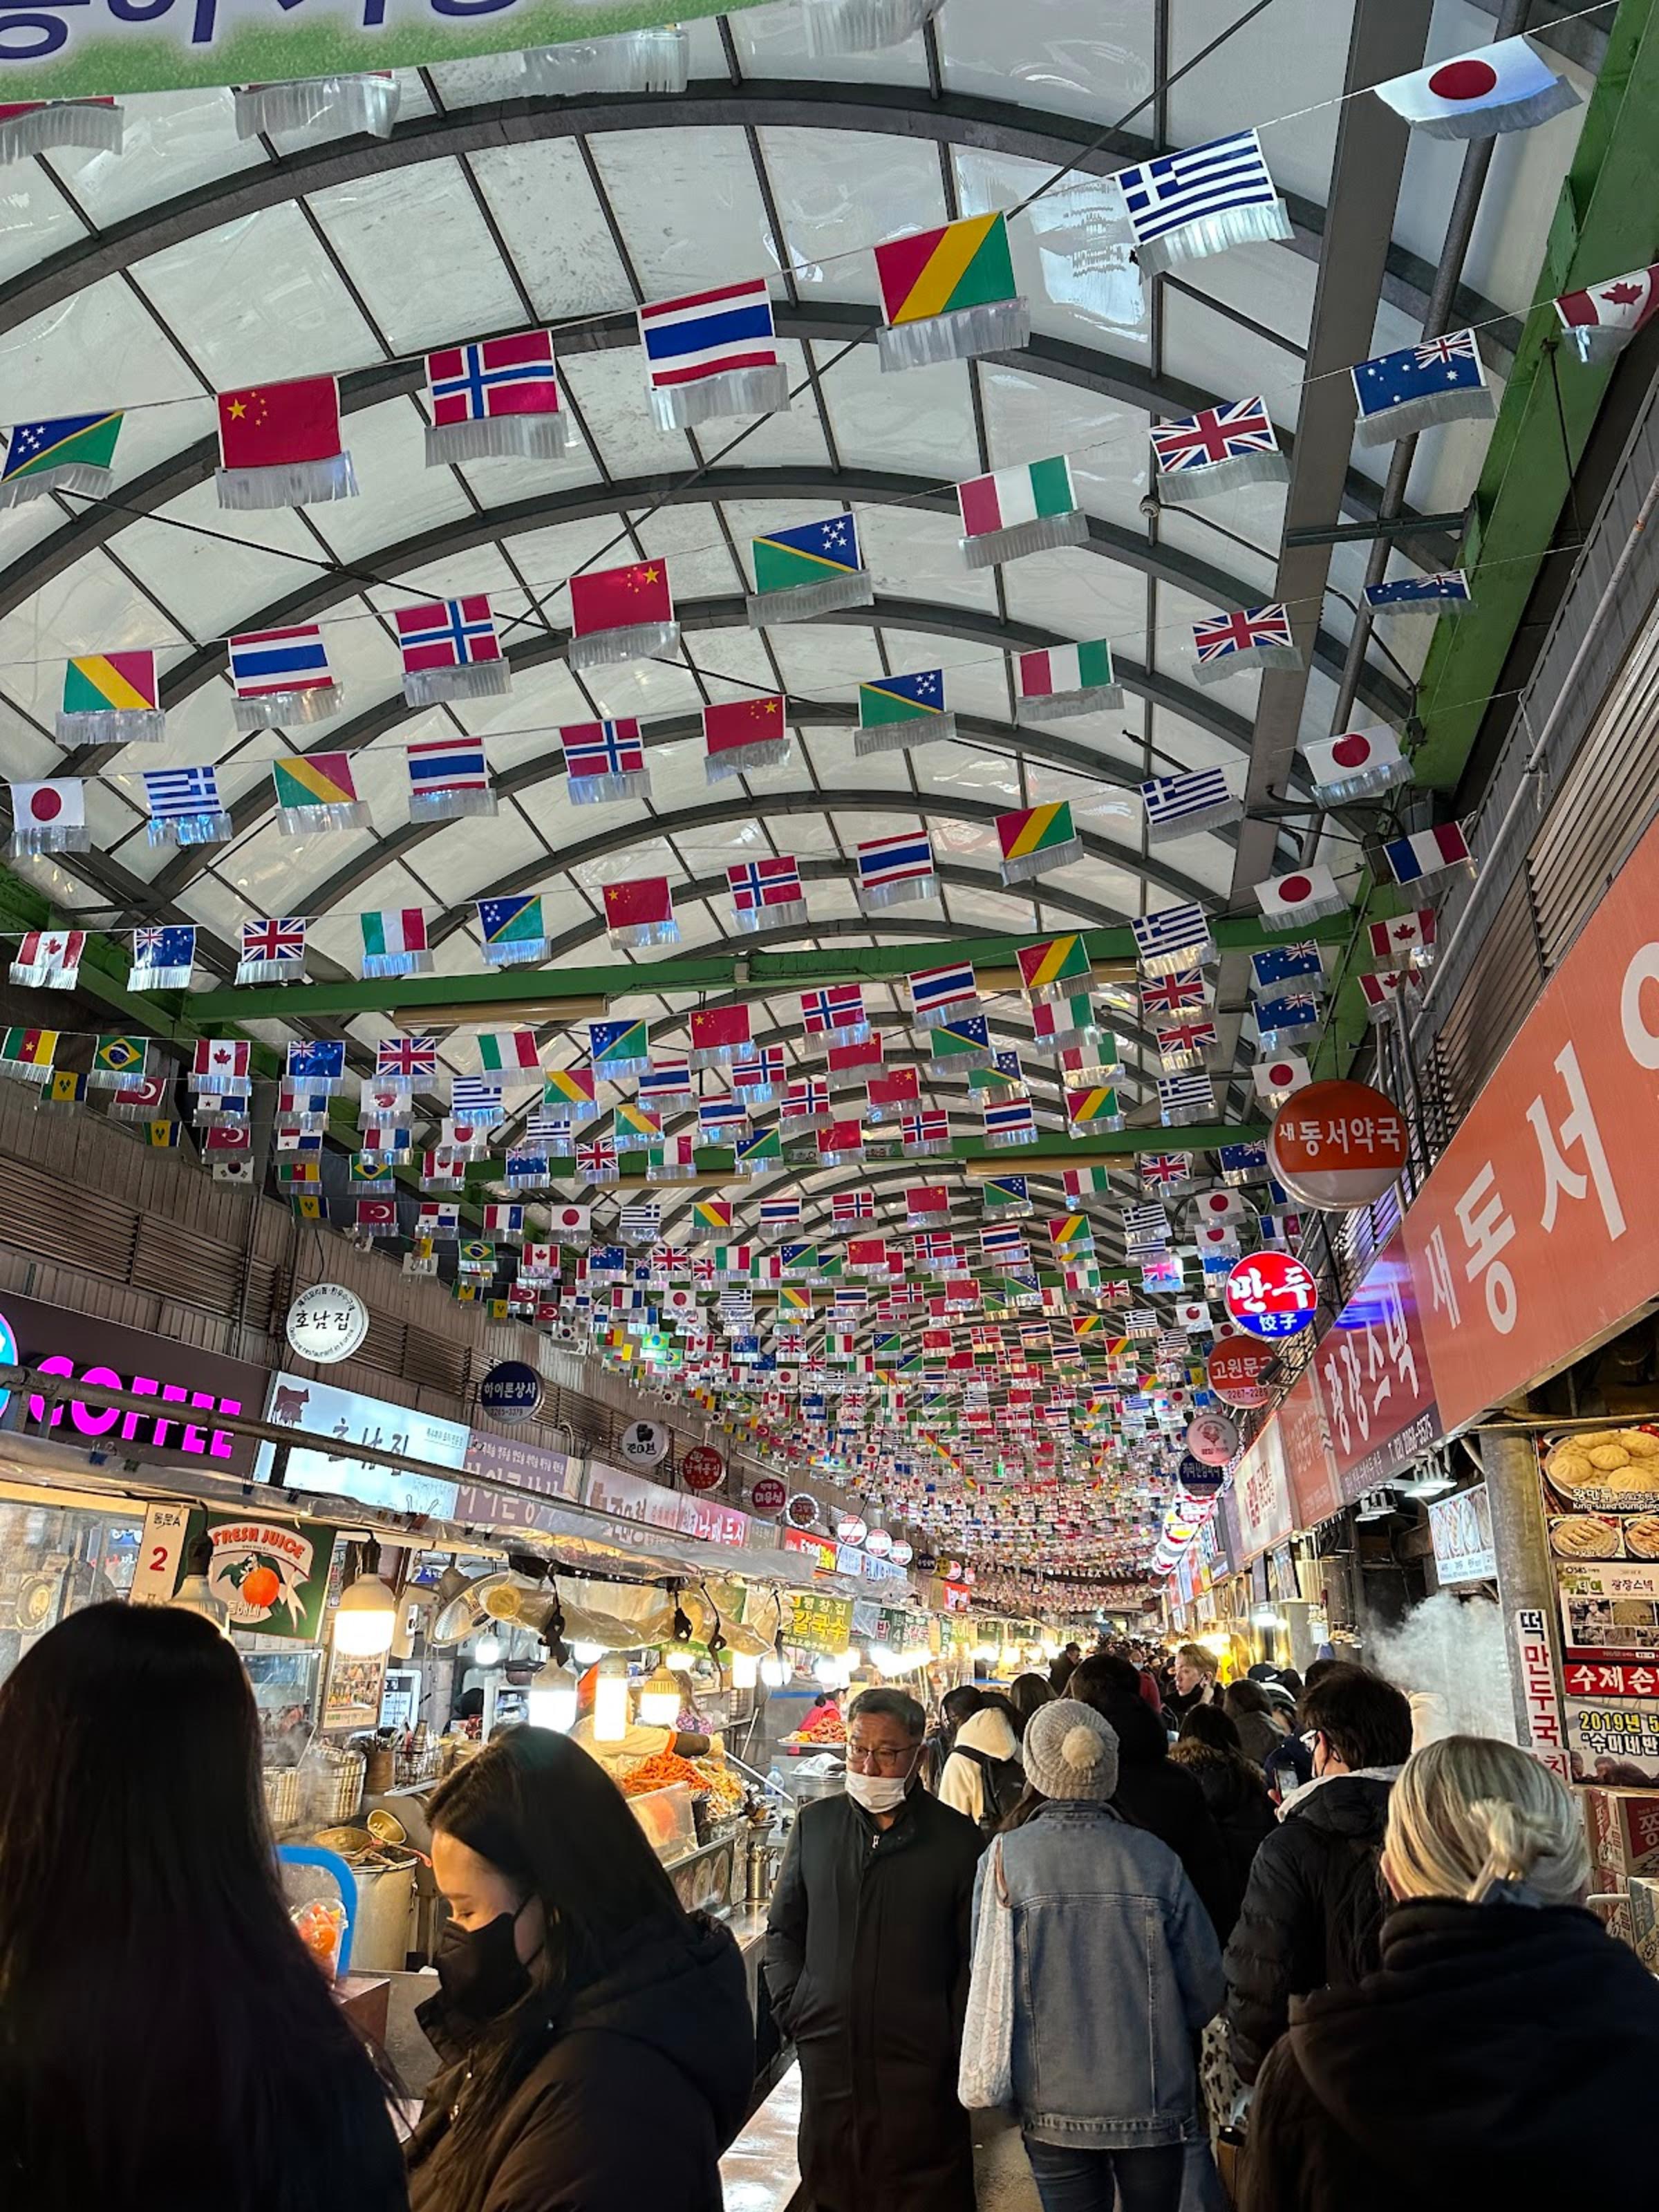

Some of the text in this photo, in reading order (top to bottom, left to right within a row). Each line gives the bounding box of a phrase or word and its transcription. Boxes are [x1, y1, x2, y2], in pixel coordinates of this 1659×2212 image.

[1279, 1117, 1400, 1156] 새동서약국
[1228, 1267, 1313, 1313] 만두
[295, 1309, 350, 1331] 호남집
[485, 1382, 536, 1398] 하이론상사
[29, 1356, 241, 1459] COFFEE
[212, 1527, 306, 1560] FRESH JUICE
[149, 1546, 168, 1572] 2
[793, 1610, 849, 1644] 칼국수
[1570, 1666, 1659, 1694] 수제손
[1580, 1712, 1642, 1734] 2019년
